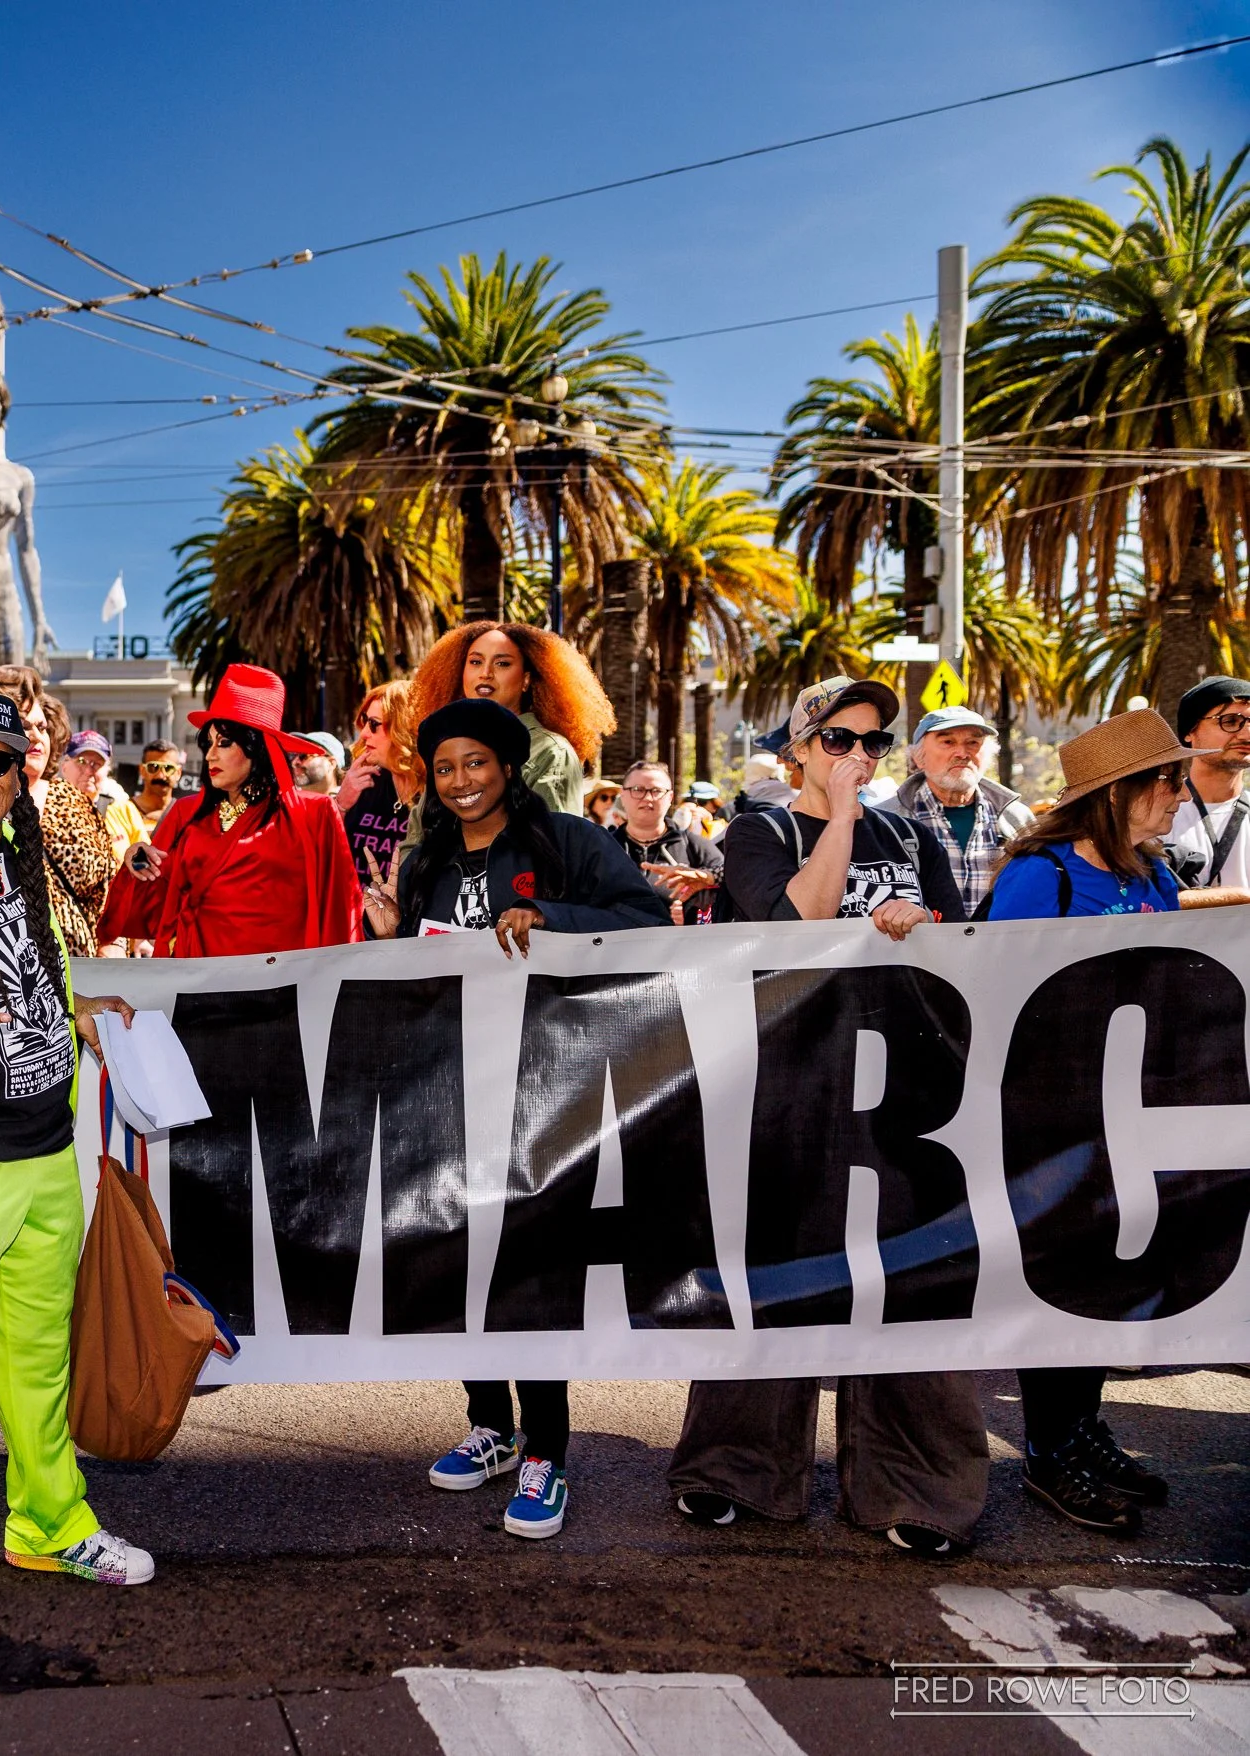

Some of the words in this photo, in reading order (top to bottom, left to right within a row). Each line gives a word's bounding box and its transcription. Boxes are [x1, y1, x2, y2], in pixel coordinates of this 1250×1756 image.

[353, 833, 400, 853] TRA
[847, 865, 880, 883] March
[46, 1053, 60, 1066] JUNE
[11, 1073, 32, 1084] RALLY
[168, 946, 1250, 1338] MARC
